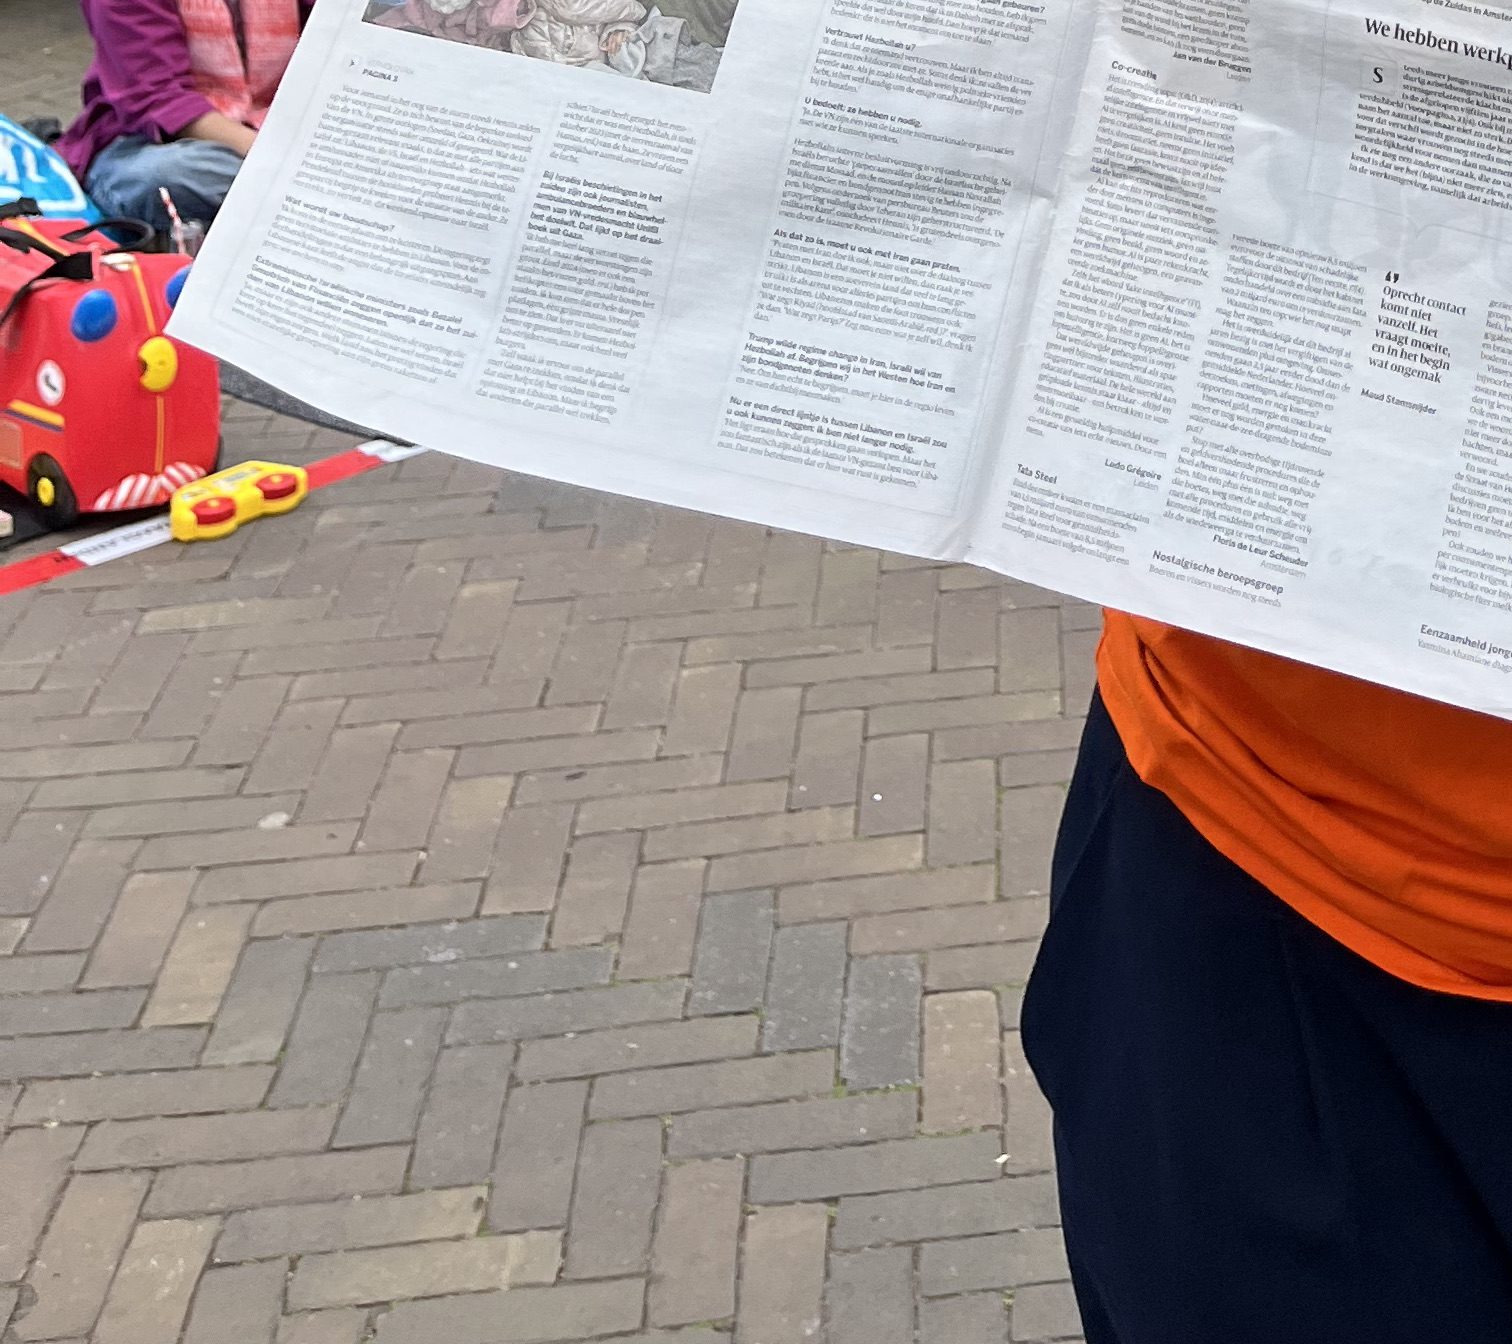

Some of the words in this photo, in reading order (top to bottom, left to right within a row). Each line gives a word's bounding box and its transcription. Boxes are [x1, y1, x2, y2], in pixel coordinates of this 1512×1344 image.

[1444, 0, 1472, 13] Zuidas
[1365, 17, 1391, 38] We
[1393, 23, 1459, 54] hebben
[1111, 60, 1157, 81] Co-creatie
[857, 106, 889, 121] hebben
[773, 228, 787, 238] Als
[788, 231, 803, 241] dat
[826, 240, 849, 251] moet
[857, 246, 873, 255] ook
[874, 250, 892, 259] met
[909, 257, 931, 267] gaan
[1380, 297, 1409, 316] komt
[1410, 308, 1432, 322] niet
[1382, 285, 1425, 306] Oprecht
[1426, 298, 1467, 316] contact
[1375, 328, 1409, 347] vraagt
[1377, 314, 1417, 334] vanzelf.
[1419, 324, 1438, 339] Het
[1368, 356, 1389, 370] wat
[1390, 362, 1441, 384] ongemak
[1371, 343, 1385, 354] en
[1386, 344, 1398, 358] in
[1399, 347, 1418, 363] het
[1419, 352, 1450, 371] begin
[733, 410, 749, 419] ook
[842, 431, 860, 442] niet
[770, 404, 795, 417] direct
[859, 422, 894, 437] Libanon
[1017, 463, 1033, 477] Tata
[1034, 469, 1058, 485] Steel
[1152, 549, 1215, 575] Nostalgische
[1216, 567, 1284, 596] beroepsgroep
[1420, 623, 1487, 651] Eenzaamheid
